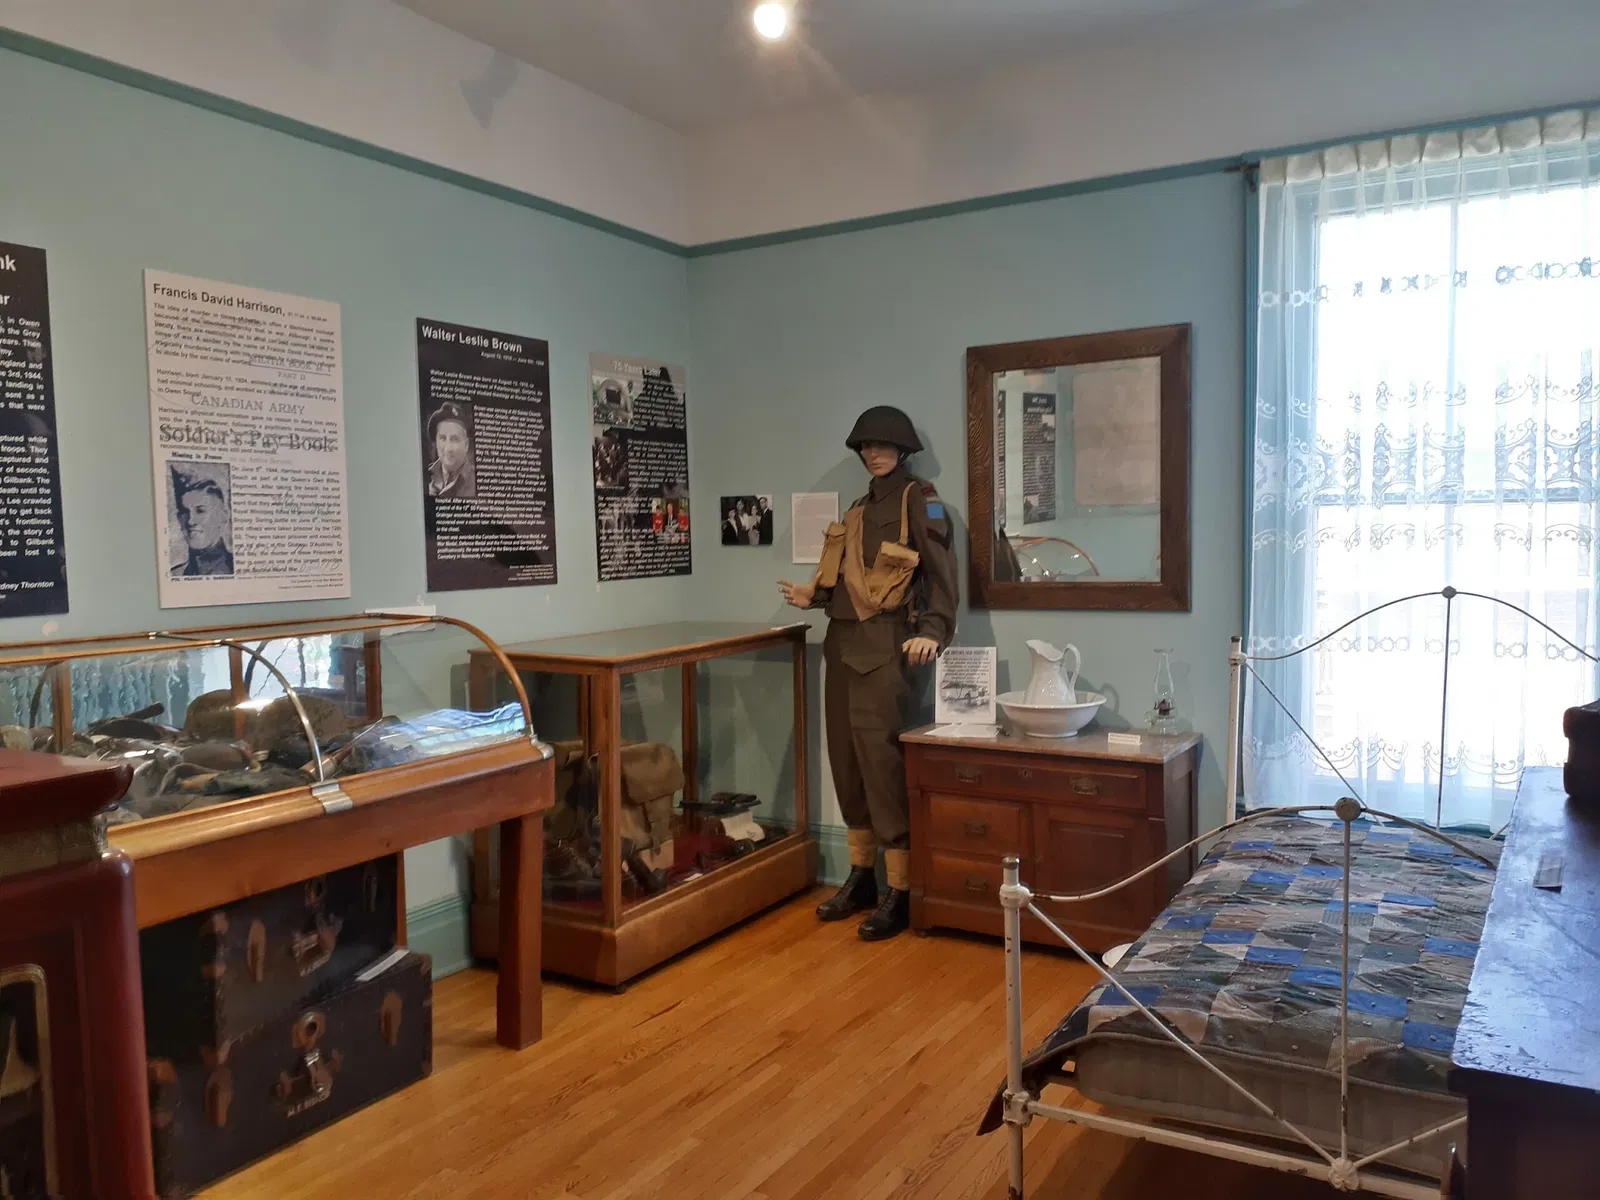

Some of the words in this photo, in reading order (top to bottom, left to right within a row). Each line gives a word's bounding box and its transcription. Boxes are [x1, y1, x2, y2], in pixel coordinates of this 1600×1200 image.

[153, 283, 198, 301] Francis
[201, 291, 234, 307] David
[236, 297, 285, 317] Harrison,
[153, 302, 165, 310] The
[18, 317, 40, 327] Owen
[7, 327, 20, 335] the
[22, 328, 41, 339] Grey
[422, 325, 456, 342] Walter
[459, 332, 489, 348] Leslie
[492, 337, 522, 353] Brown
[22, 339, 41, 348] Then
[23, 371, 43, 380] 1944,
[5, 380, 33, 390] landing
[8, 401, 24, 409] that
[191, 395, 263, 411] CANADIAN
[269, 399, 305, 415] ARMY
[250, 429, 281, 451] Pay
[290, 433, 337, 452] Book
[29, 445, 48, 455] They
[172, 451, 193, 459] Missing
[34, 456, 49, 464] and
[16, 467, 50, 475] seconds,
[36, 476, 50, 484] The
[22, 497, 52, 505] crawled
[19, 508, 32, 516] get
[7, 528, 20, 536] the
[23, 529, 43, 537] story
[26, 538, 55, 546] Gilbank
[25, 548, 40, 556] lost
[47, 548, 55, 556] to
[21, 581, 54, 589] Thornton
